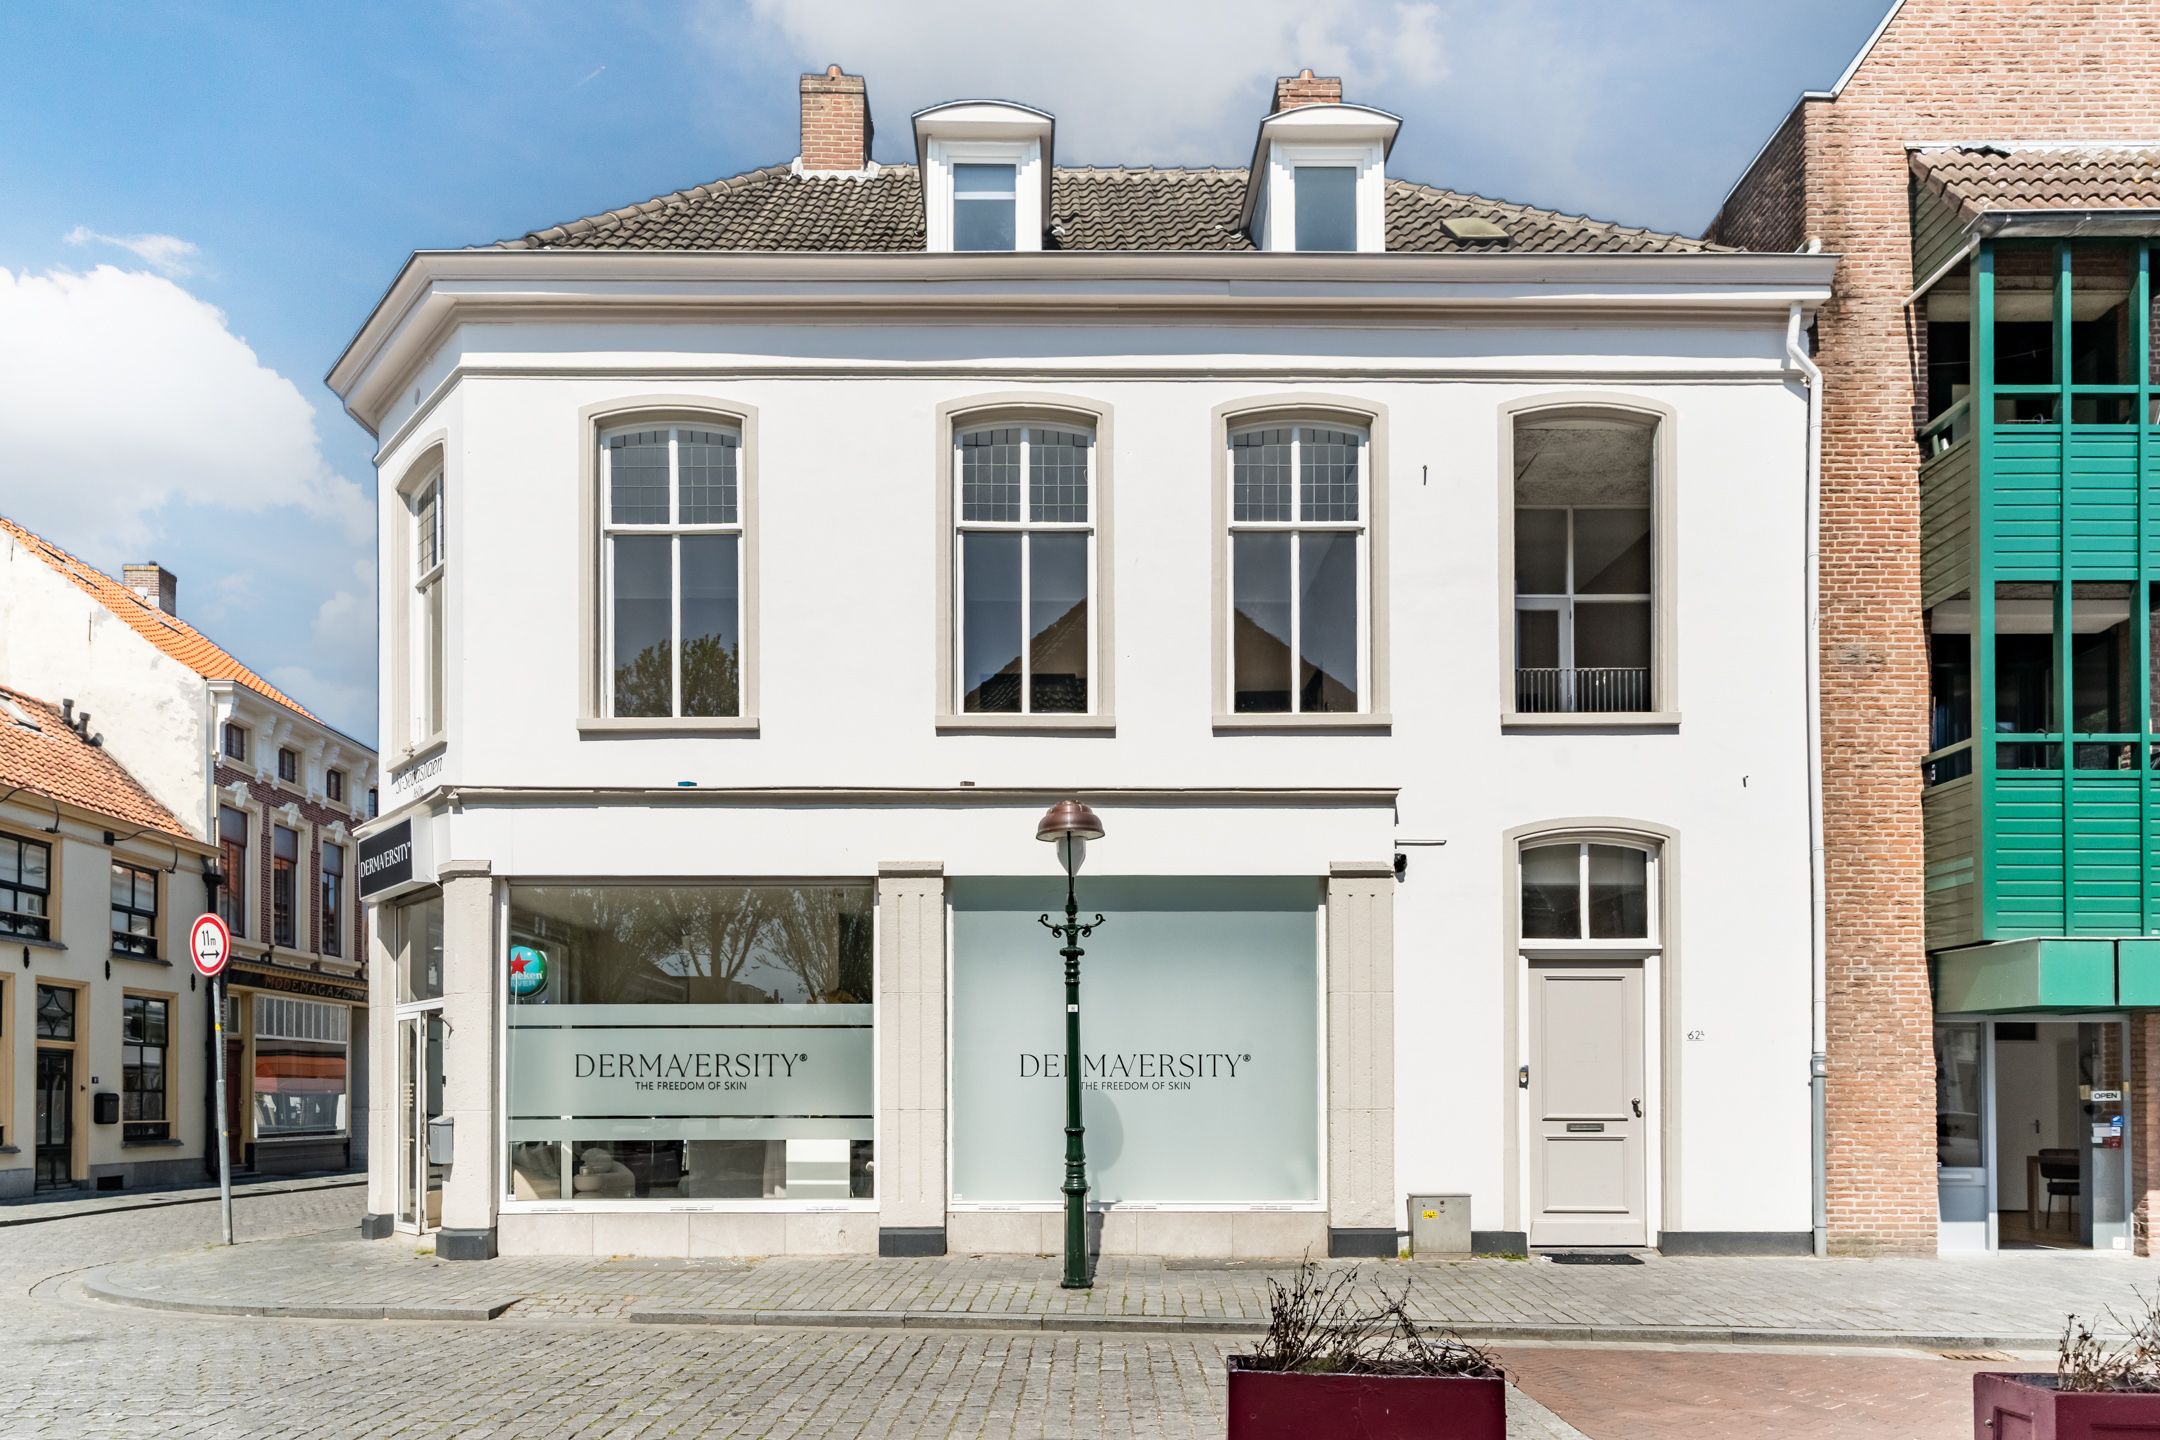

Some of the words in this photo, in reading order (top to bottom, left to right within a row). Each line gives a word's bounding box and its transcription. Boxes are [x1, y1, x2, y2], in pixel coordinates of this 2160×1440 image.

[635, 1081, 654, 1090] THE
[657, 1081, 705, 1090] FREEDOM
[708, 1081, 721, 1090] OF
[724, 1081, 747, 1090] SKIN
[1101, 1081, 1149, 1090] FREEDOM
[1152, 1081, 1165, 1090] OF
[1168, 1081, 1191, 1090] SKIN
